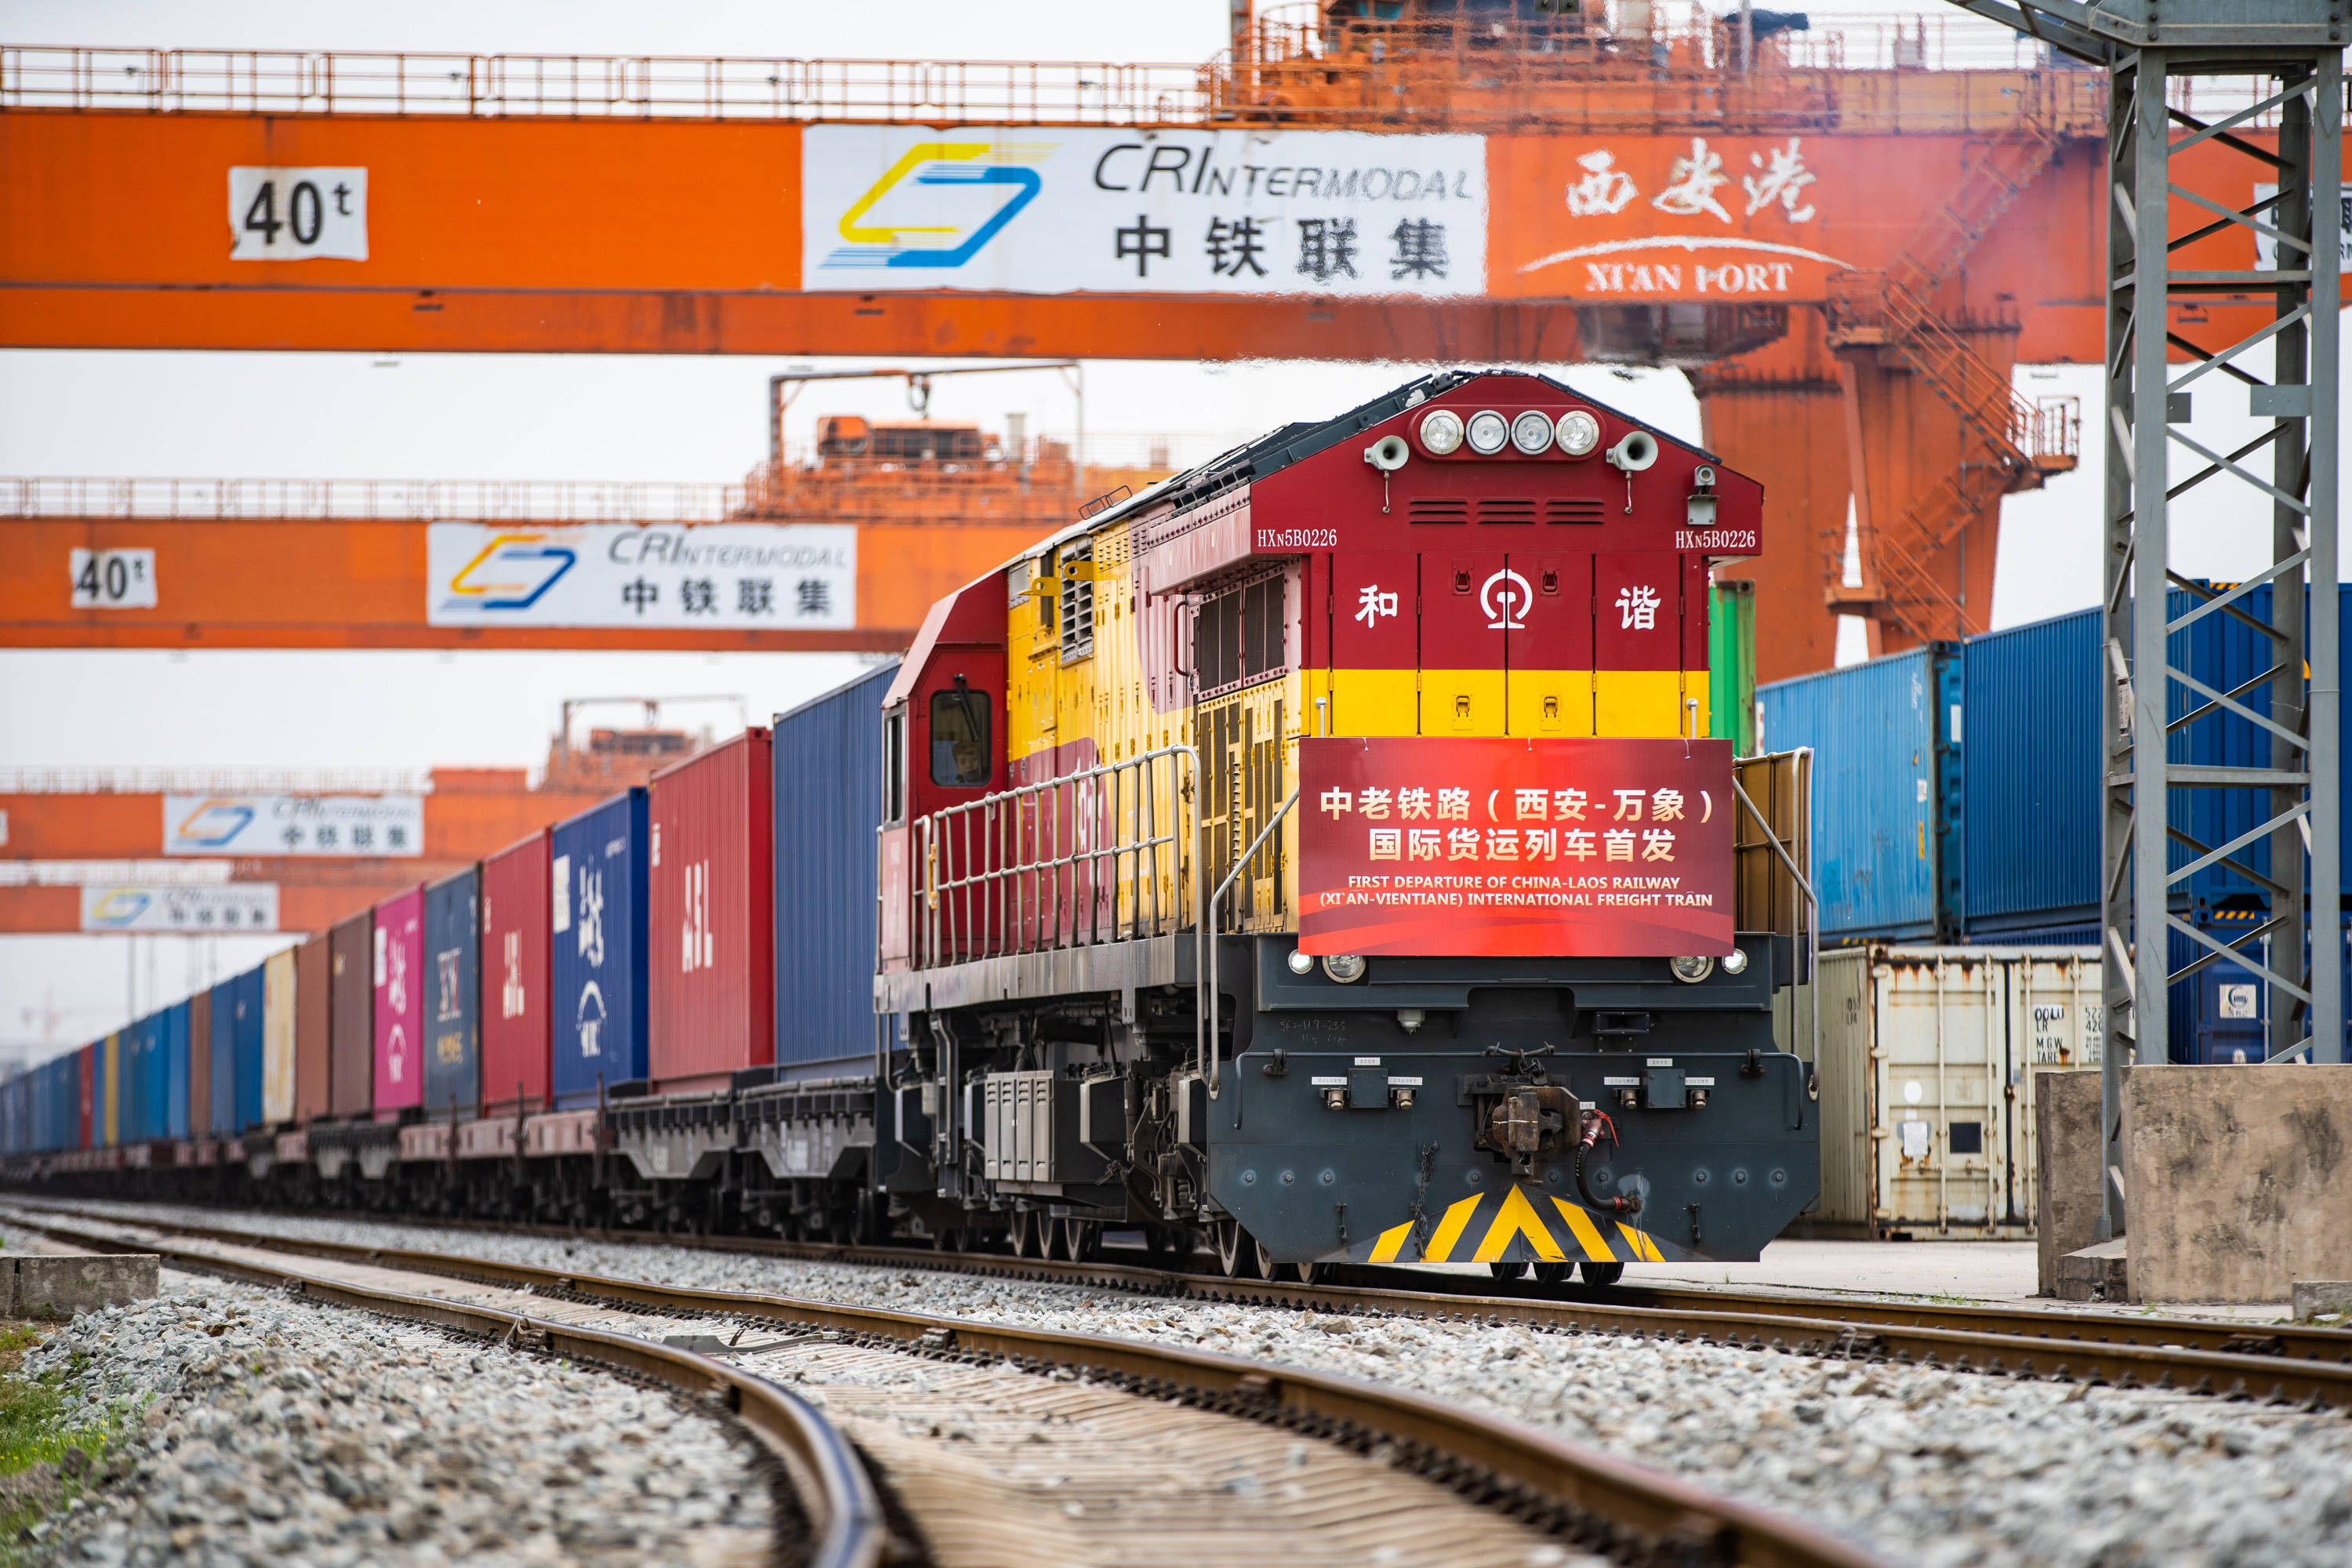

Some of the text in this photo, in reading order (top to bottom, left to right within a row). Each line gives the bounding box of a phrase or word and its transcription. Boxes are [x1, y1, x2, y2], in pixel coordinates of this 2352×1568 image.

[1566, 136, 1817, 223] 西安港
[245, 180, 352, 245] 40t
[1115, 214, 1449, 281] 中铁联集
[1694, 263, 1793, 292] PORT
[622, 576, 831, 616] 中铁联集
[1354, 583, 1661, 630] 和 谐
[1369, 828, 1676, 862] 国际货运列车首发
[1348, 876, 1680, 889] FIRST DEPARTURE OF CHINA-LAOS RAILWAY
[1468, 892, 1593, 906] INTERNATIONAL
[1598, 893, 1661, 906] FREIGHT
[1667, 894, 1713, 906] TRAIN
